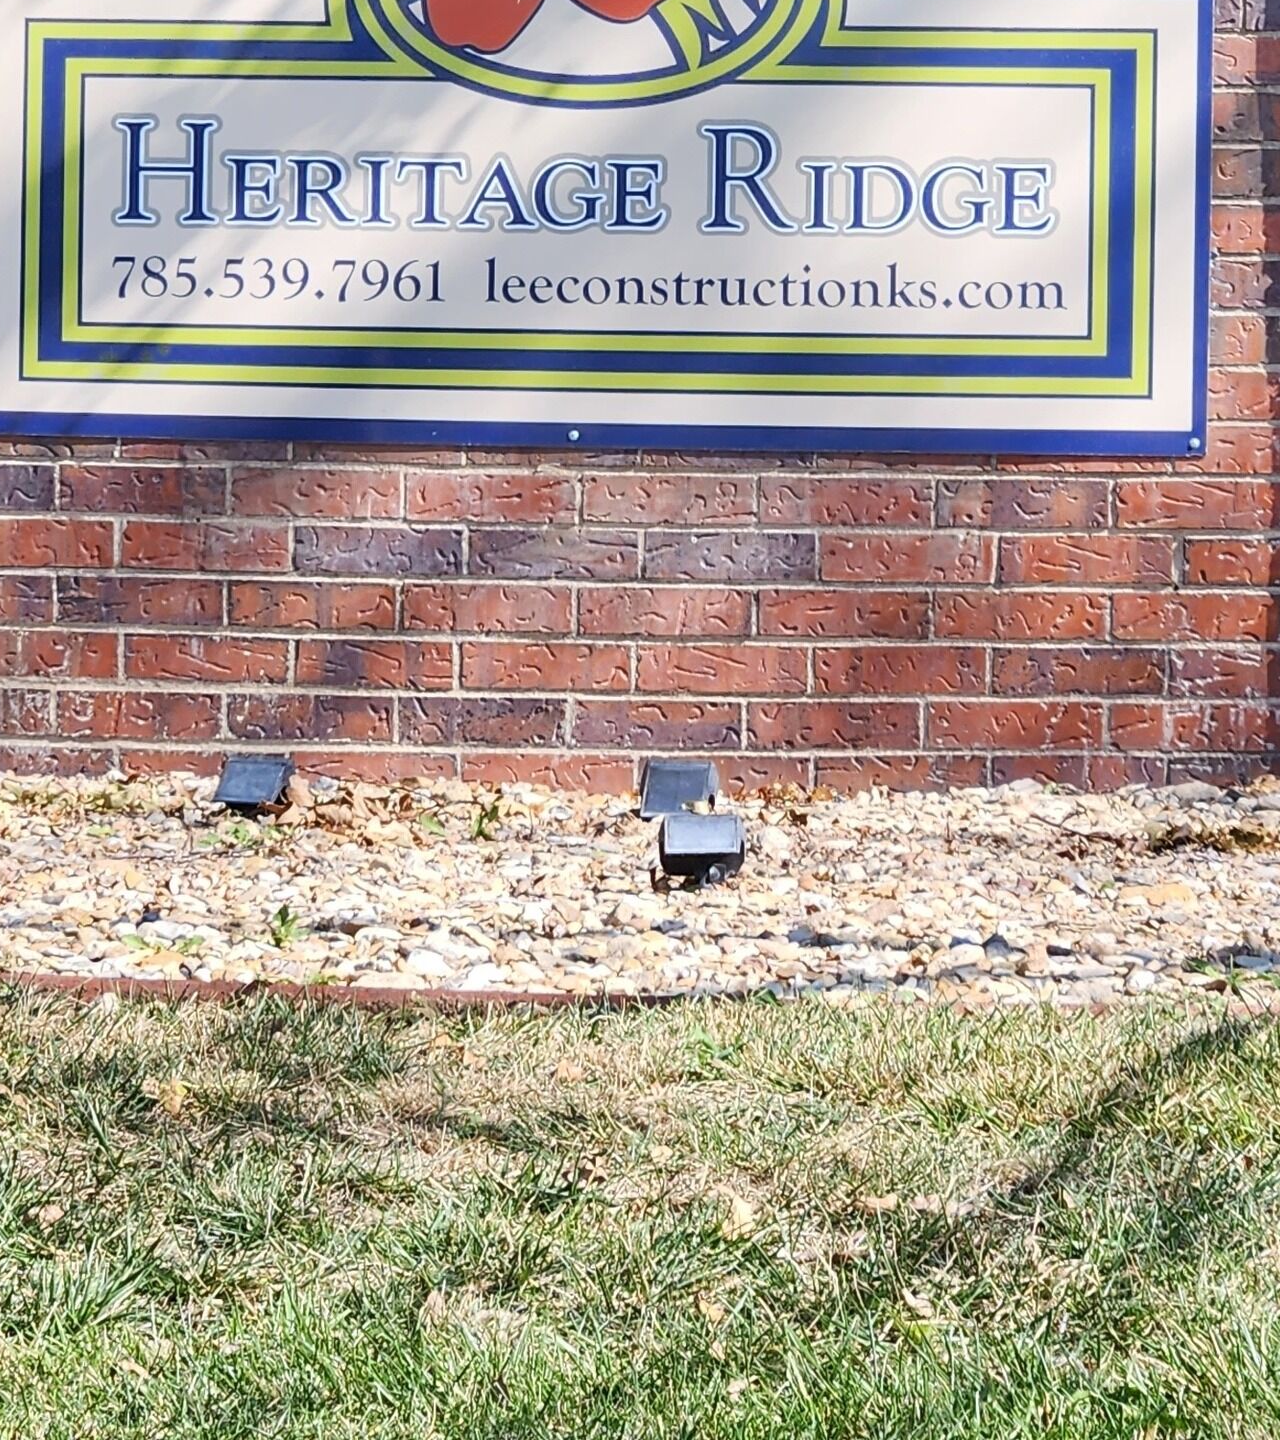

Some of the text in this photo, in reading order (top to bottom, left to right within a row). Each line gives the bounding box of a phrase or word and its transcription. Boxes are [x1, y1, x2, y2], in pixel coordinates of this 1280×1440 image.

[116, 118, 1056, 234] HERITAGE RIDGE
[111, 255, 1068, 312] 785.539.7961 leeconstructionks.com
